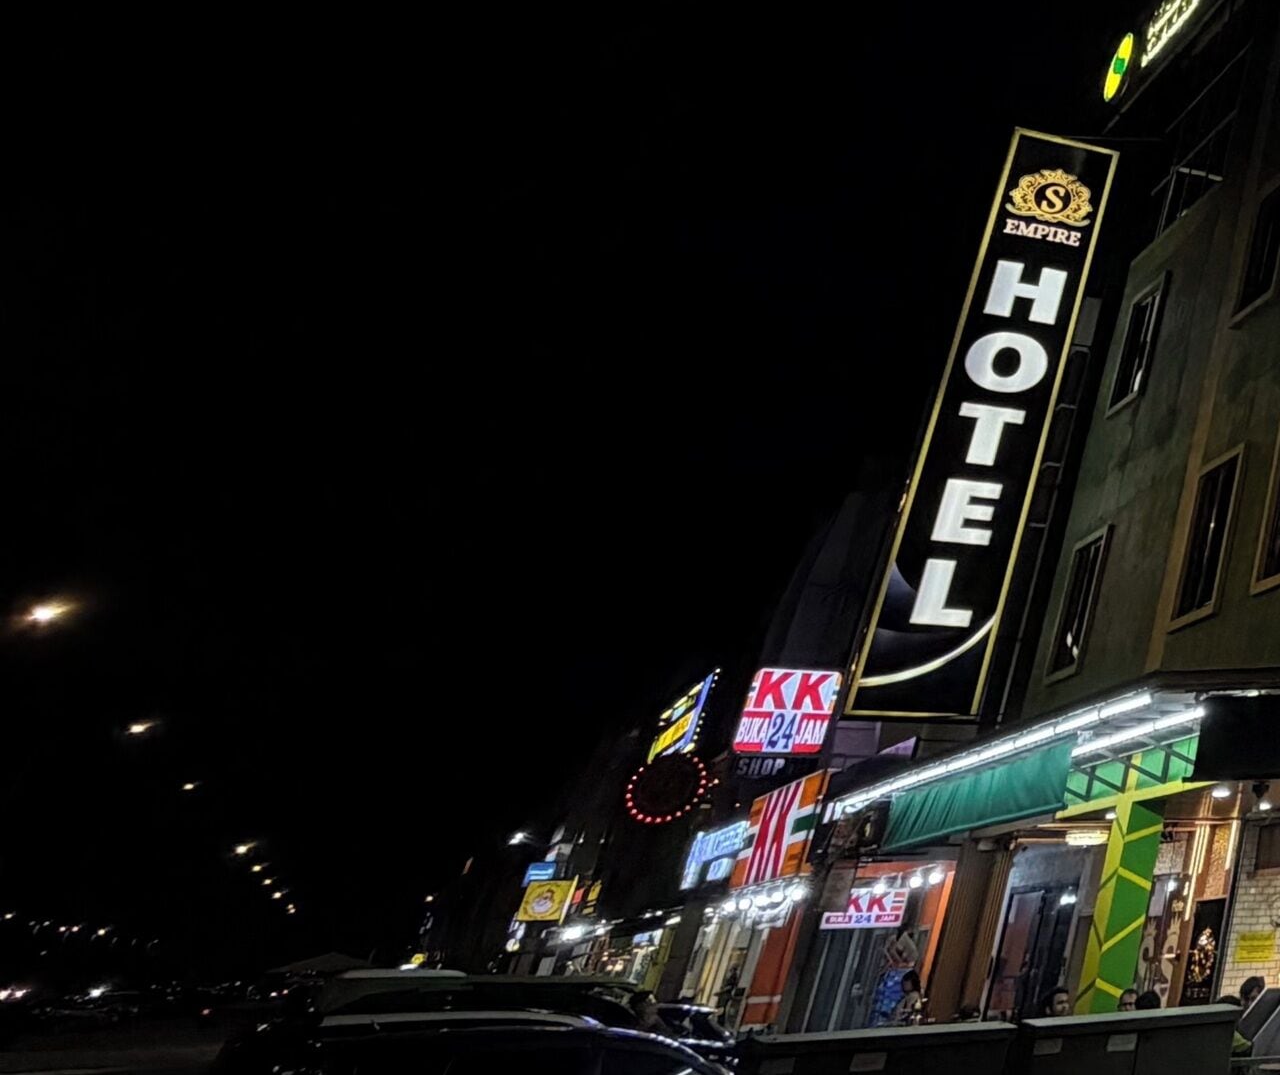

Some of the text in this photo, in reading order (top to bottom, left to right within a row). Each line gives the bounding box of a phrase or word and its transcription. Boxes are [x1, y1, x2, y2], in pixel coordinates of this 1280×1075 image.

[1040, 185, 1066, 214] S
[1003, 218, 1082, 247] EMPIRE
[909, 259, 1068, 628] HOTEL
[752, 671, 834, 711] KK
[737, 713, 830, 749] BUKA 24 JAM
[736, 758, 786, 775] SHOP
[744, 779, 804, 886] KK
[847, 891, 891, 913] KK
[854, 914, 872, 924] 24
